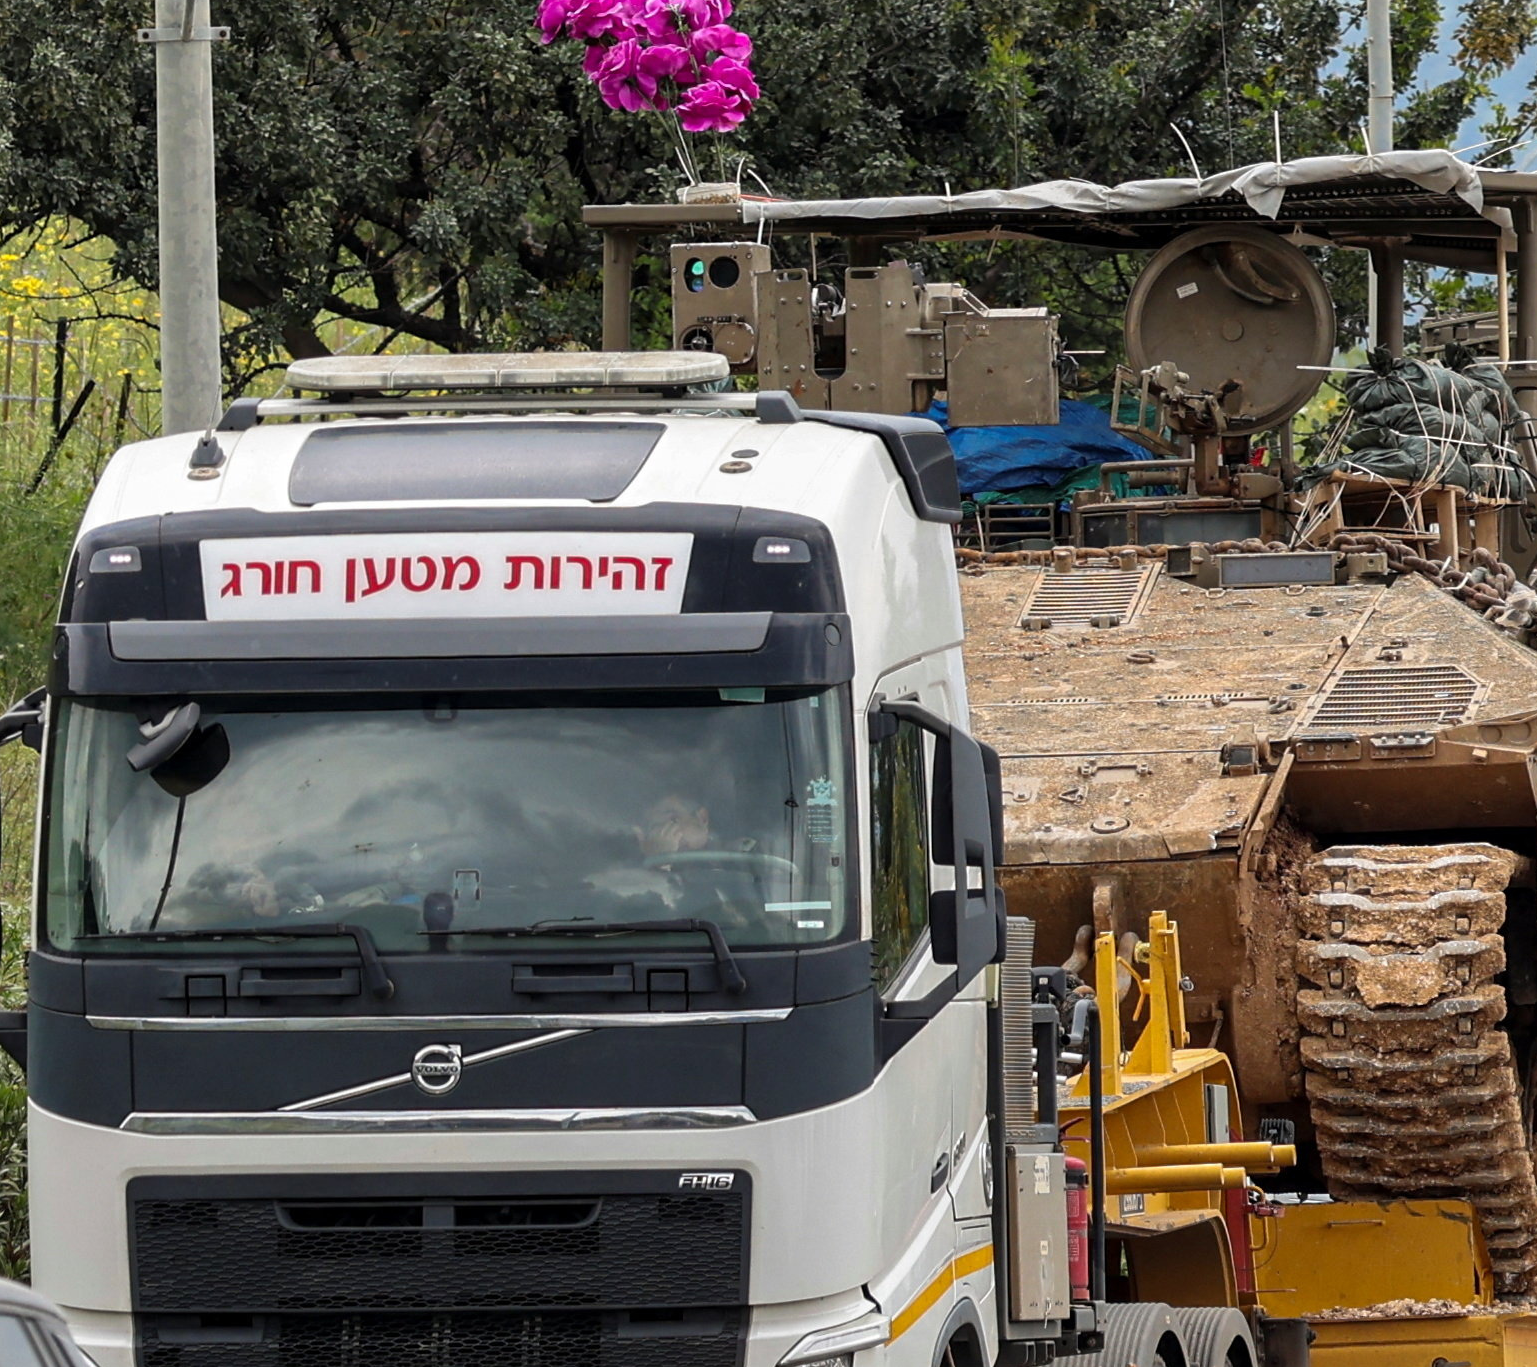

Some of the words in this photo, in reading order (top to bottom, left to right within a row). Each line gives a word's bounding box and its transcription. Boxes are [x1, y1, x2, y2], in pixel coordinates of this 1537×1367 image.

[219, 559, 322, 598] חורג
[343, 552, 482, 603] מטען
[502, 554, 674, 592] זהירות
[414, 1064, 459, 1074] VOLVO
[678, 1172, 735, 1190] FH16
